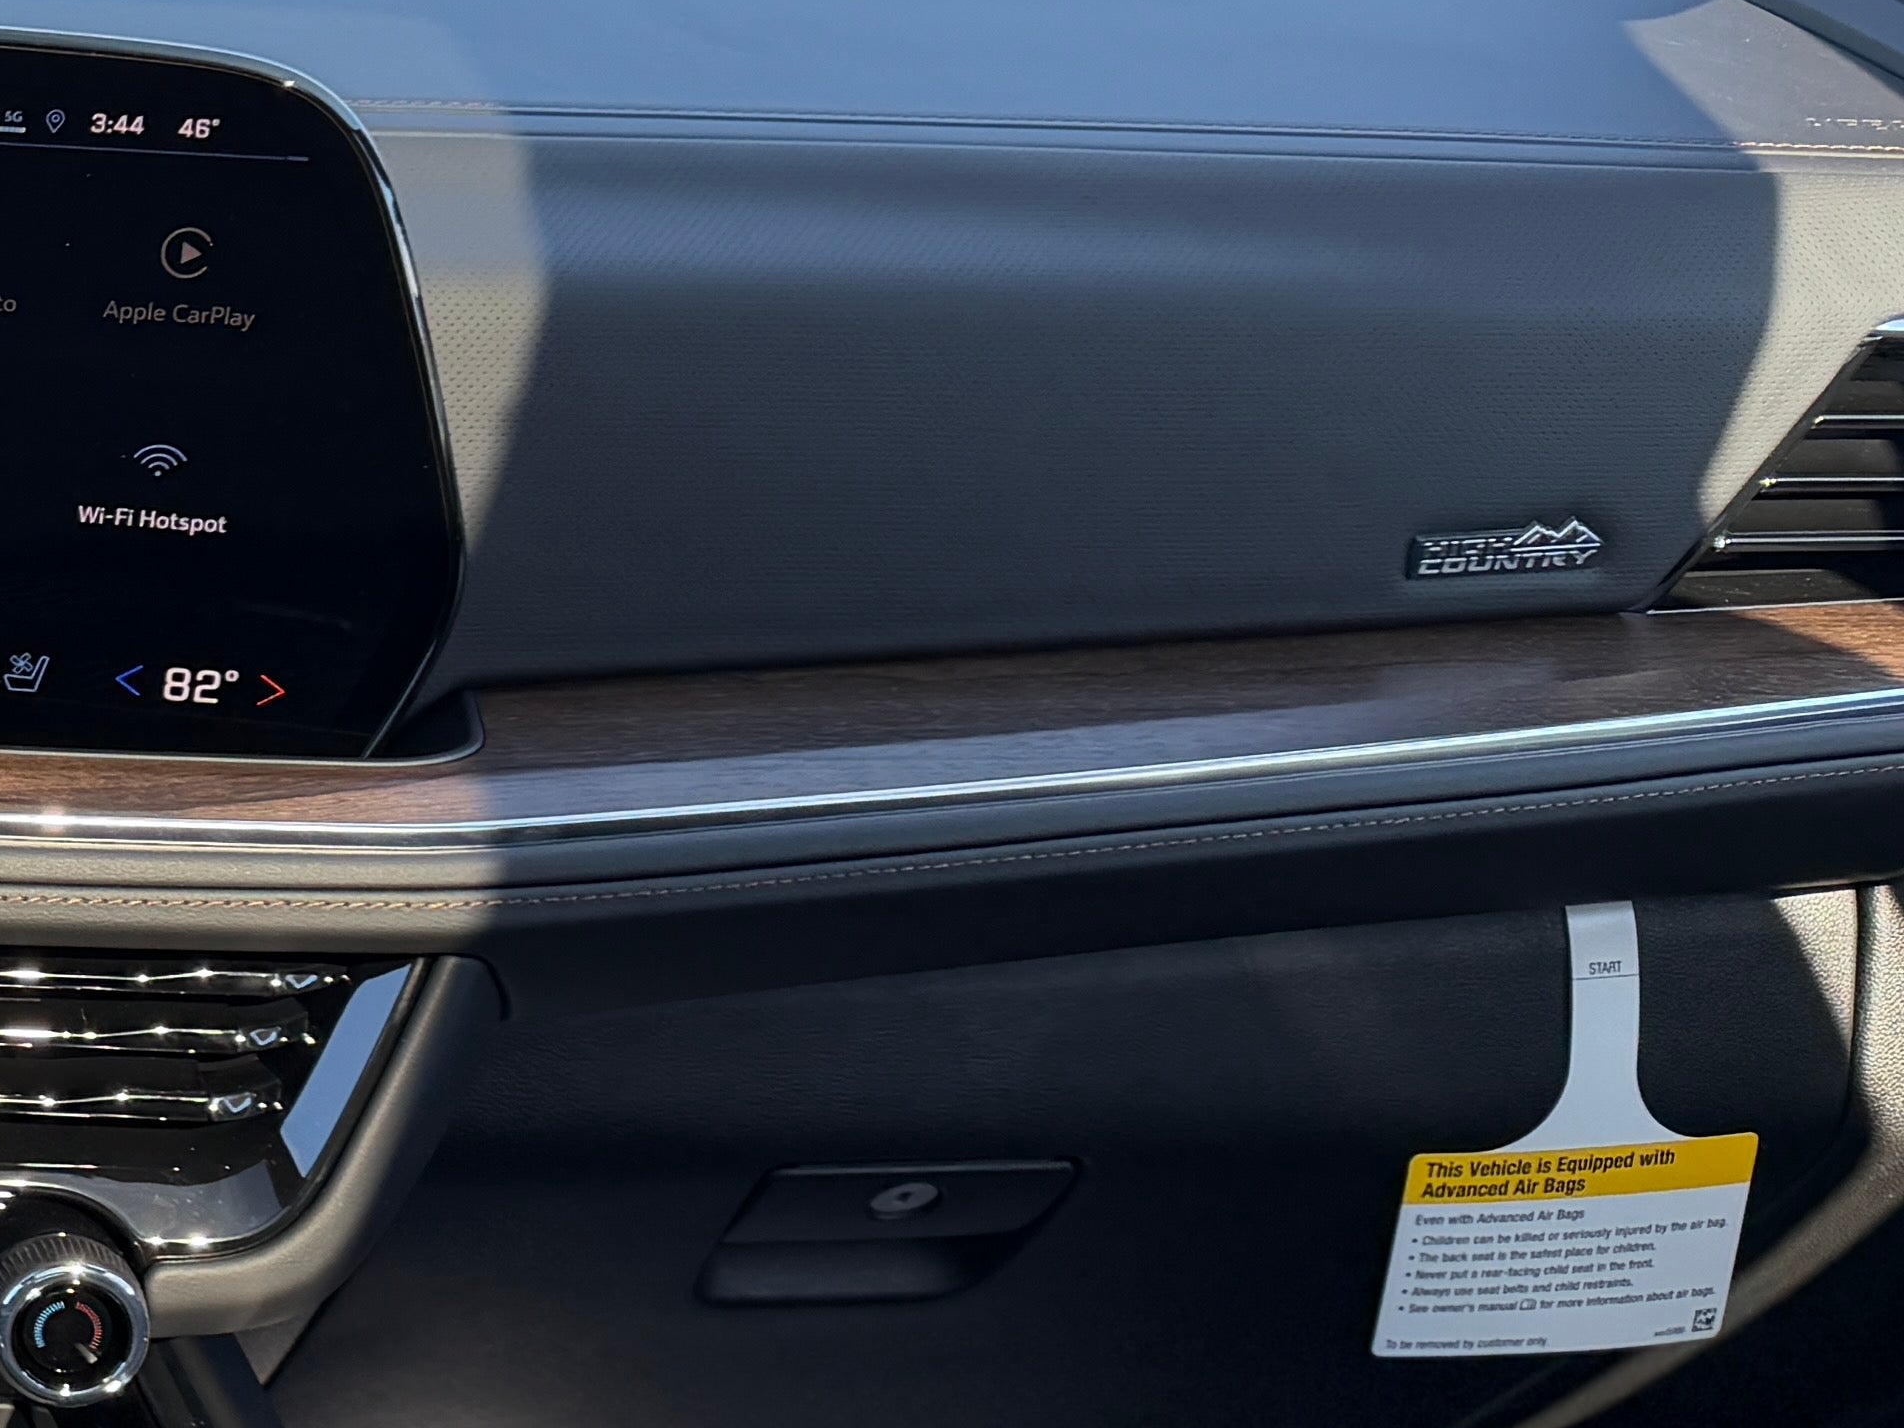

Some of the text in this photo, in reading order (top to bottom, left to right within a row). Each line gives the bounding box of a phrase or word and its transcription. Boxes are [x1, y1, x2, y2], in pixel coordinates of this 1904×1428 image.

[90, 112, 145, 137] 3:44
[103, 299, 256, 331] Apple CarPlay
[77, 504, 228, 536] Wi-Fi Hotspot
[1418, 549, 1598, 575] COUNTRY
[162, 667, 241, 705] 82°
[1588, 960, 1622, 976] START
[1427, 1149, 1675, 1178] This Vehicle is Equipped with
[1422, 1176, 1585, 1198] Advanced Air Bags
[1415, 1208, 1585, 1226] Even with Advanced Air Bags
[1422, 1235, 1470, 1246] Children
[1473, 1235, 1494, 1245] can
[1497, 1233, 1511, 1244] be
[1514, 1231, 1545, 1243] killed
[1548, 1232, 1560, 1241] or
[1562, 1227, 1612, 1243] seriously
[1615, 1224, 1652, 1239] injured
[1655, 1224, 1667, 1234] by
[1671, 1222, 1687, 1232] the
[1419, 1252, 1439, 1262] The
[1442, 1251, 1467, 1262] back
[1472, 1251, 1495, 1262] seat
[1510, 1250, 1527, 1260] the
[1530, 1248, 1563, 1260] safest
[1564, 1246, 1594, 1260] place
[1596, 1245, 1611, 1255] for
[1543, 1264, 1570, 1275] child
[1609, 1261, 1626, 1271] the
[1411, 1286, 1451, 1298] Always
[1477, 1285, 1500, 1296] seat
[1532, 1282, 1552, 1293] and
[1554, 1281, 1580, 1292] child
[1557, 1298, 1584, 1309] more
[1586, 1293, 1644, 1307] information
[1645, 1290, 1674, 1303] about
